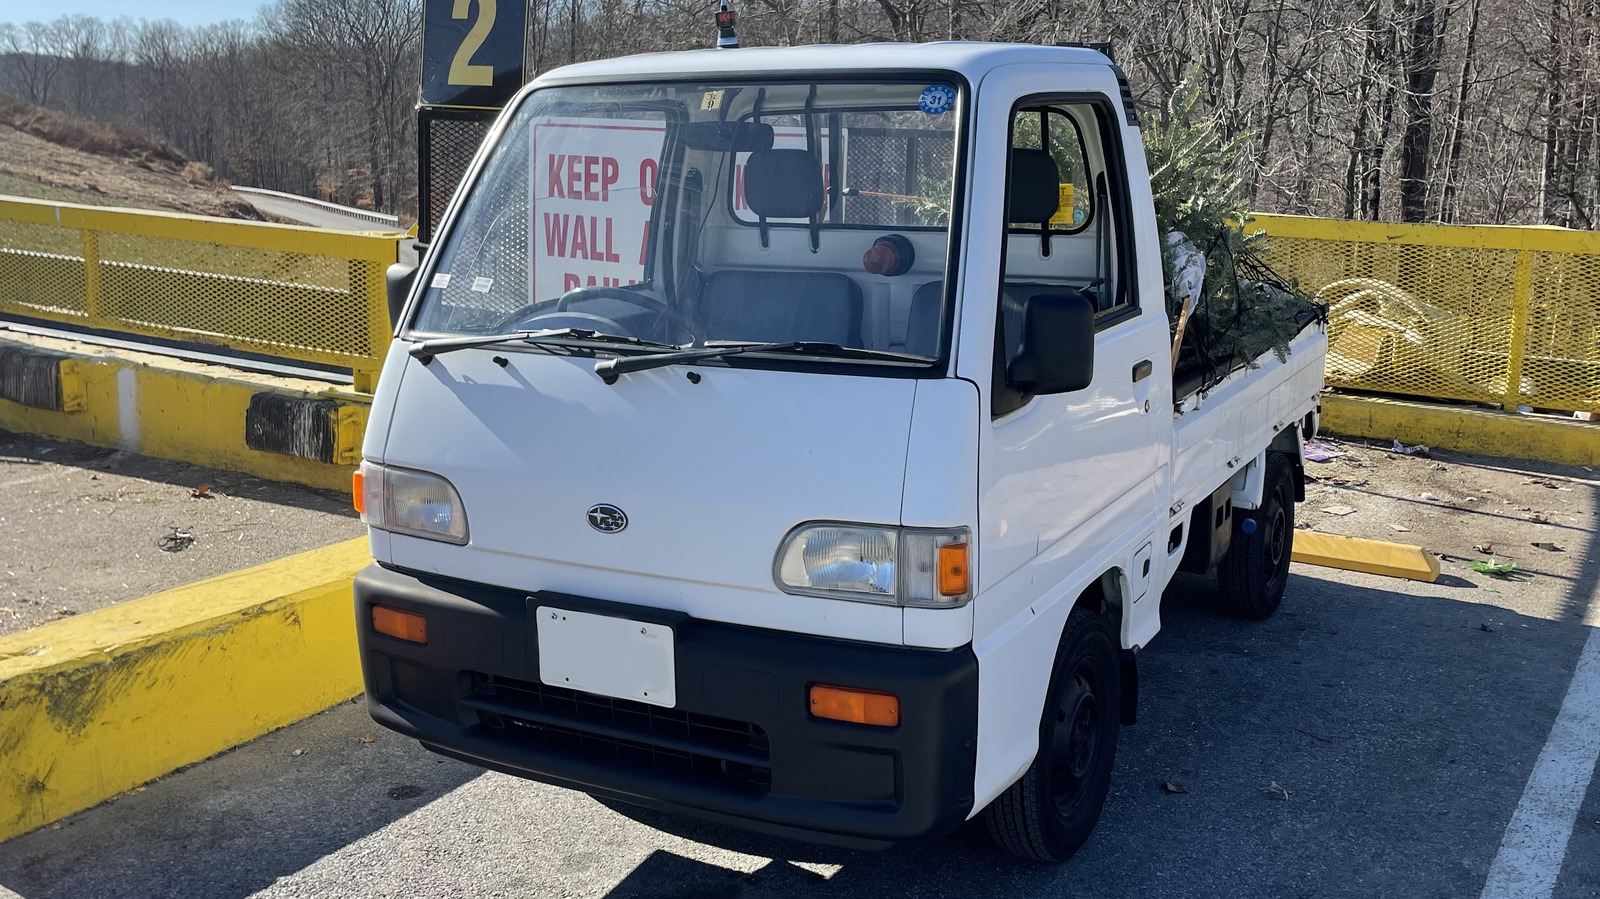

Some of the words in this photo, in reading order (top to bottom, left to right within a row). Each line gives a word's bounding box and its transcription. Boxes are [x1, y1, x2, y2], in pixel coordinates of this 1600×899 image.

[448, 0, 497, 86] 2
[930, 95, 942, 105] 31
[548, 154, 619, 202] KEEP
[543, 212, 620, 263] WALL
